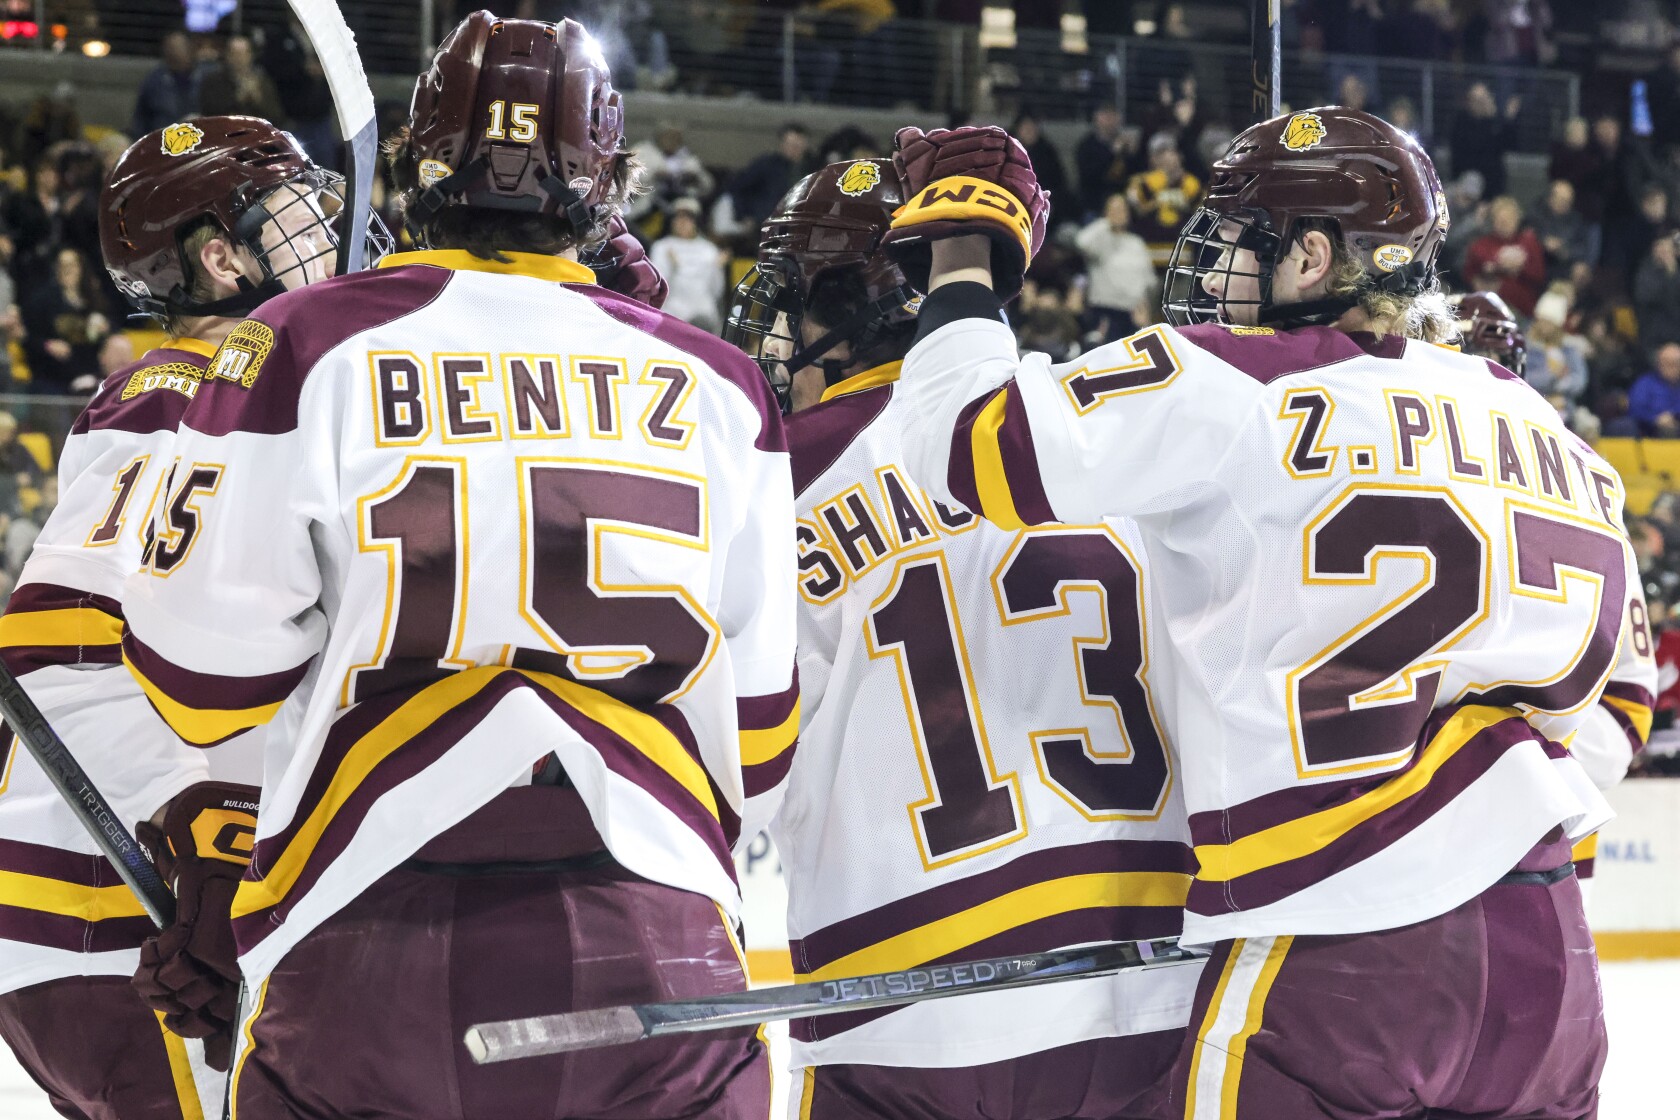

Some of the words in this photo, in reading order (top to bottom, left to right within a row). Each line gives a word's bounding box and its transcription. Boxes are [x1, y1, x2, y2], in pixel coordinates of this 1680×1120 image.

[486, 100, 539, 142] 15
[571, 181, 592, 189] NCHC
[367, 351, 697, 450] BENTZ
[1278, 387, 1378, 479] Z.
[139, 456, 226, 579] 5
[341, 455, 721, 708] 15
[1286, 482, 1627, 779] 27
[862, 521, 1173, 872] 13
[77, 782, 131, 854] TRIGGER
[819, 962, 995, 1004] JETSPEED
